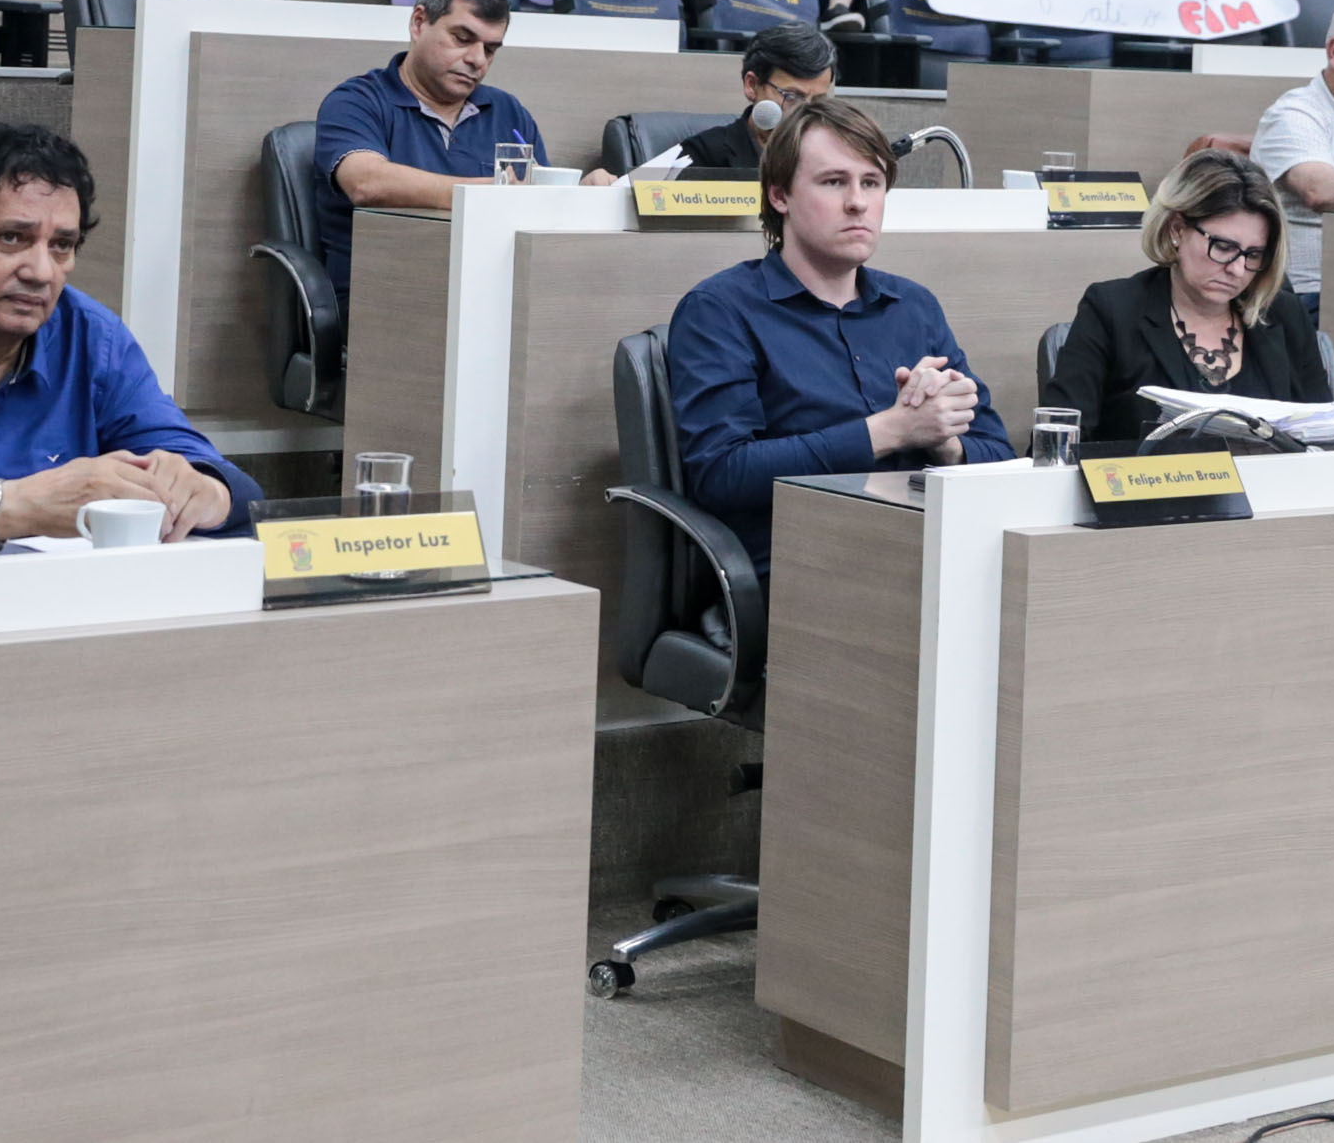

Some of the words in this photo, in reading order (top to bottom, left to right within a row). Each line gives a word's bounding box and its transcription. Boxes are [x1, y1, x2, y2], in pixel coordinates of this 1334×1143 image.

[672, 192, 703, 205] Vladi
[705, 193, 757, 207] Lourenço
[1128, 473, 1163, 487] Felipe
[1164, 471, 1195, 484] Kuhn
[1197, 469, 1231, 482] Braun
[333, 534, 412, 556] Inspetor
[418, 531, 450, 549] Luz
